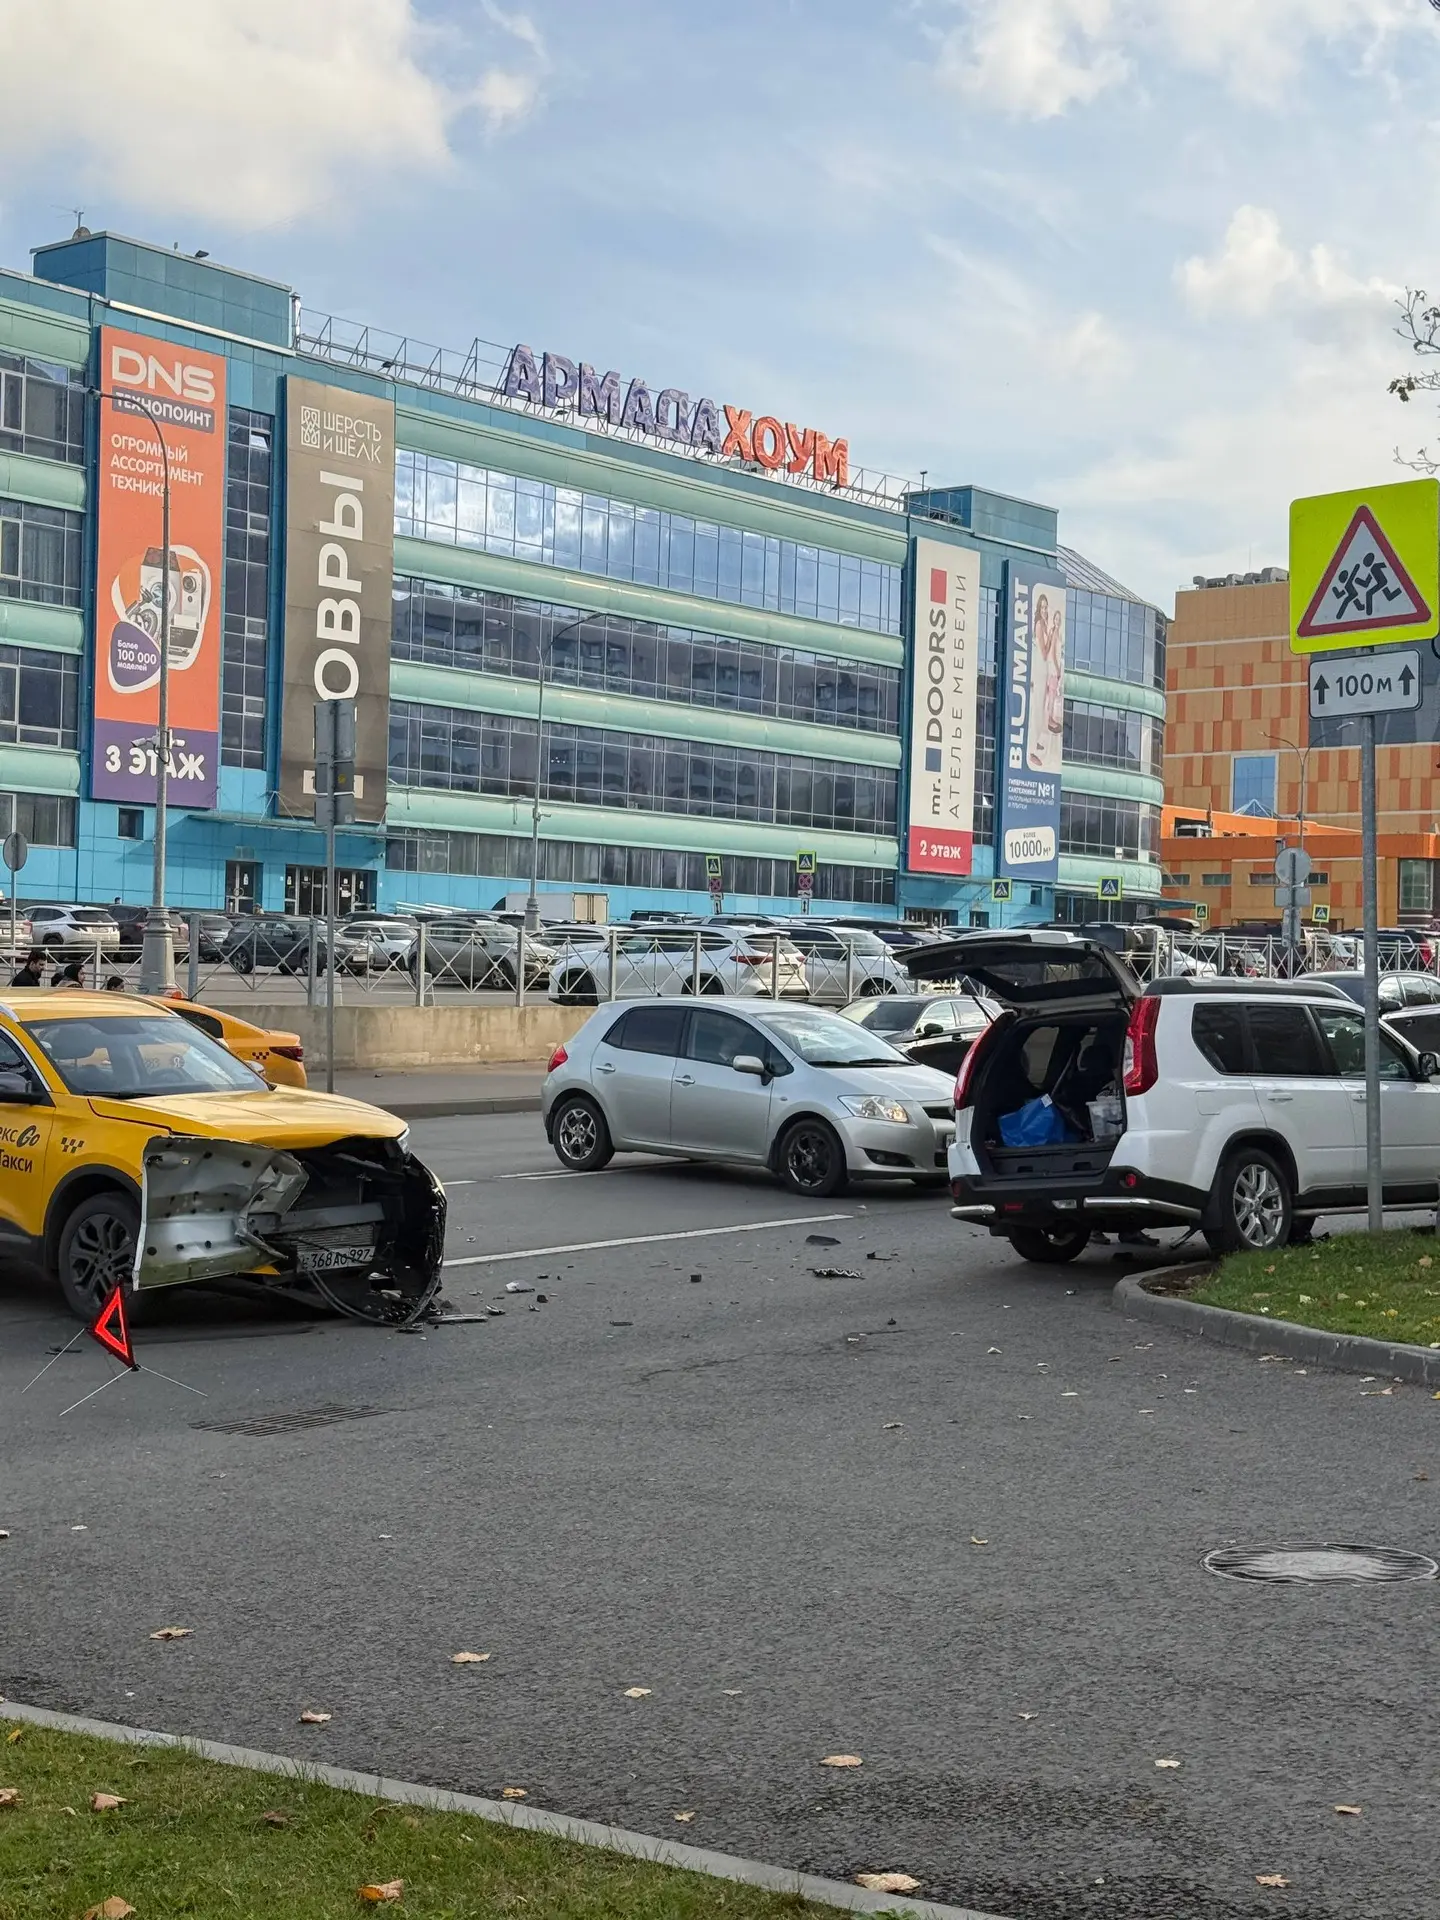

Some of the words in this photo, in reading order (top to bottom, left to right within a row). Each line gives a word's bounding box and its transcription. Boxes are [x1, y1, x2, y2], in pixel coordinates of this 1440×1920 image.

[112, 345, 215, 403] DNS
[115, 392, 212, 428] ТЕХНОПОИНТ
[323, 410, 382, 442] ШЕРСТЬ
[111, 433, 188, 463] ОГРОМНЫЙ
[323, 434, 333, 452] И
[110, 453, 204, 486] АССОРТИМЕНТ
[312, 470, 364, 751] ОВРЫ
[117, 639, 138, 650] Более
[953, 574, 966, 694] МЕБЕЛИ
[117, 661, 147, 671] моделей
[118, 649, 135, 662] 100
[138, 651, 157, 665] 000
[1009, 577, 1029, 769] BLUMART
[927, 608, 947, 743] DOORS
[105, 744, 121, 773] 3
[128, 747, 205, 781] ЭТАЖ
[949, 707, 963, 819] АТЕЛЬЕ
[932, 778, 941, 815] mr.
[919, 839, 927, 856] 2
[930, 844, 961, 859] этаж
[17, 1125, 40, 1148] Go
